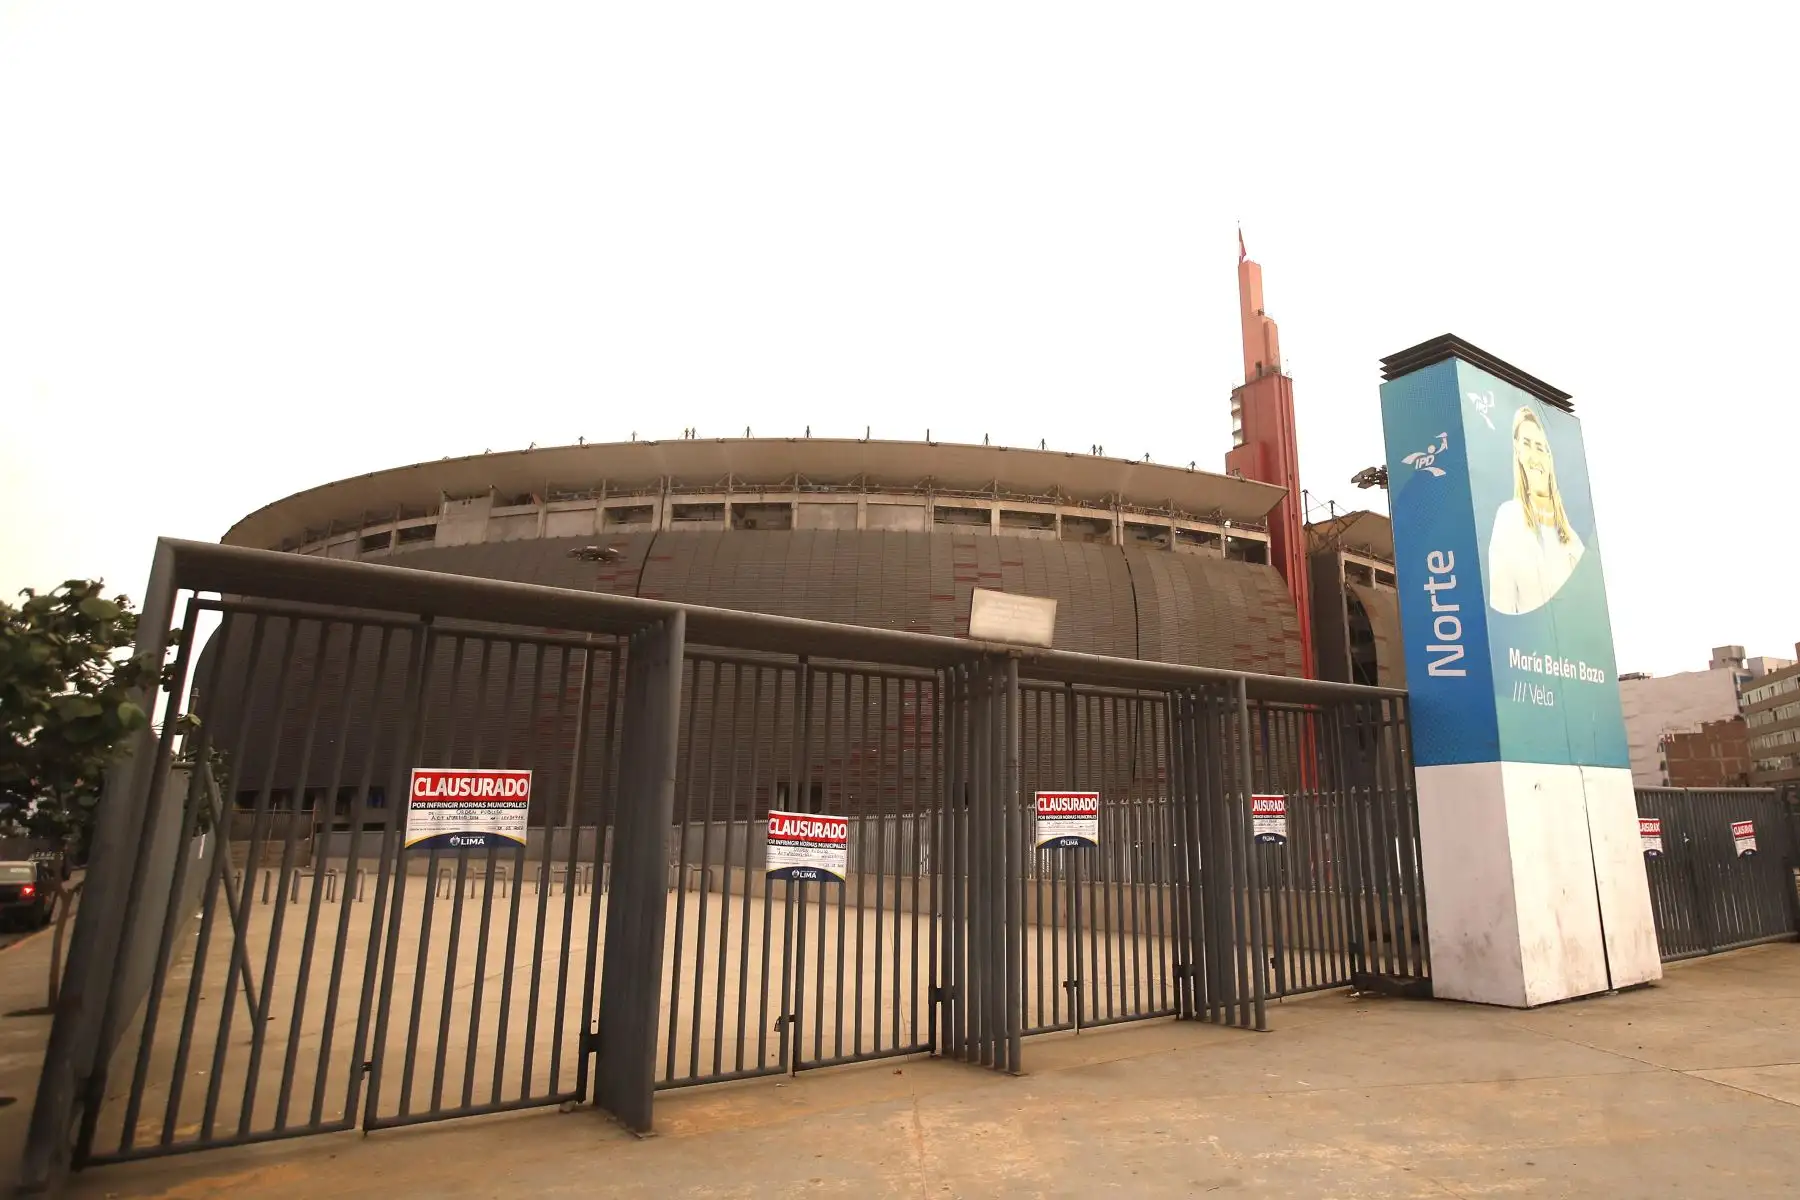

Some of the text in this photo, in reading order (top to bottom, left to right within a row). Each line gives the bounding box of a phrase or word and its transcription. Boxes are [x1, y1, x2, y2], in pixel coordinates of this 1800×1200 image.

[1415, 455, 1435, 469] IPD
[1423, 550, 1467, 677] Norte
[1509, 647, 1605, 684] María Belén Bazo
[1529, 682, 1554, 707] Vela
[413, 777, 529, 797] CLAUSURADO
[1038, 797, 1097, 811] CLAUSURADO
[768, 817, 847, 839] CLAUSURADO
